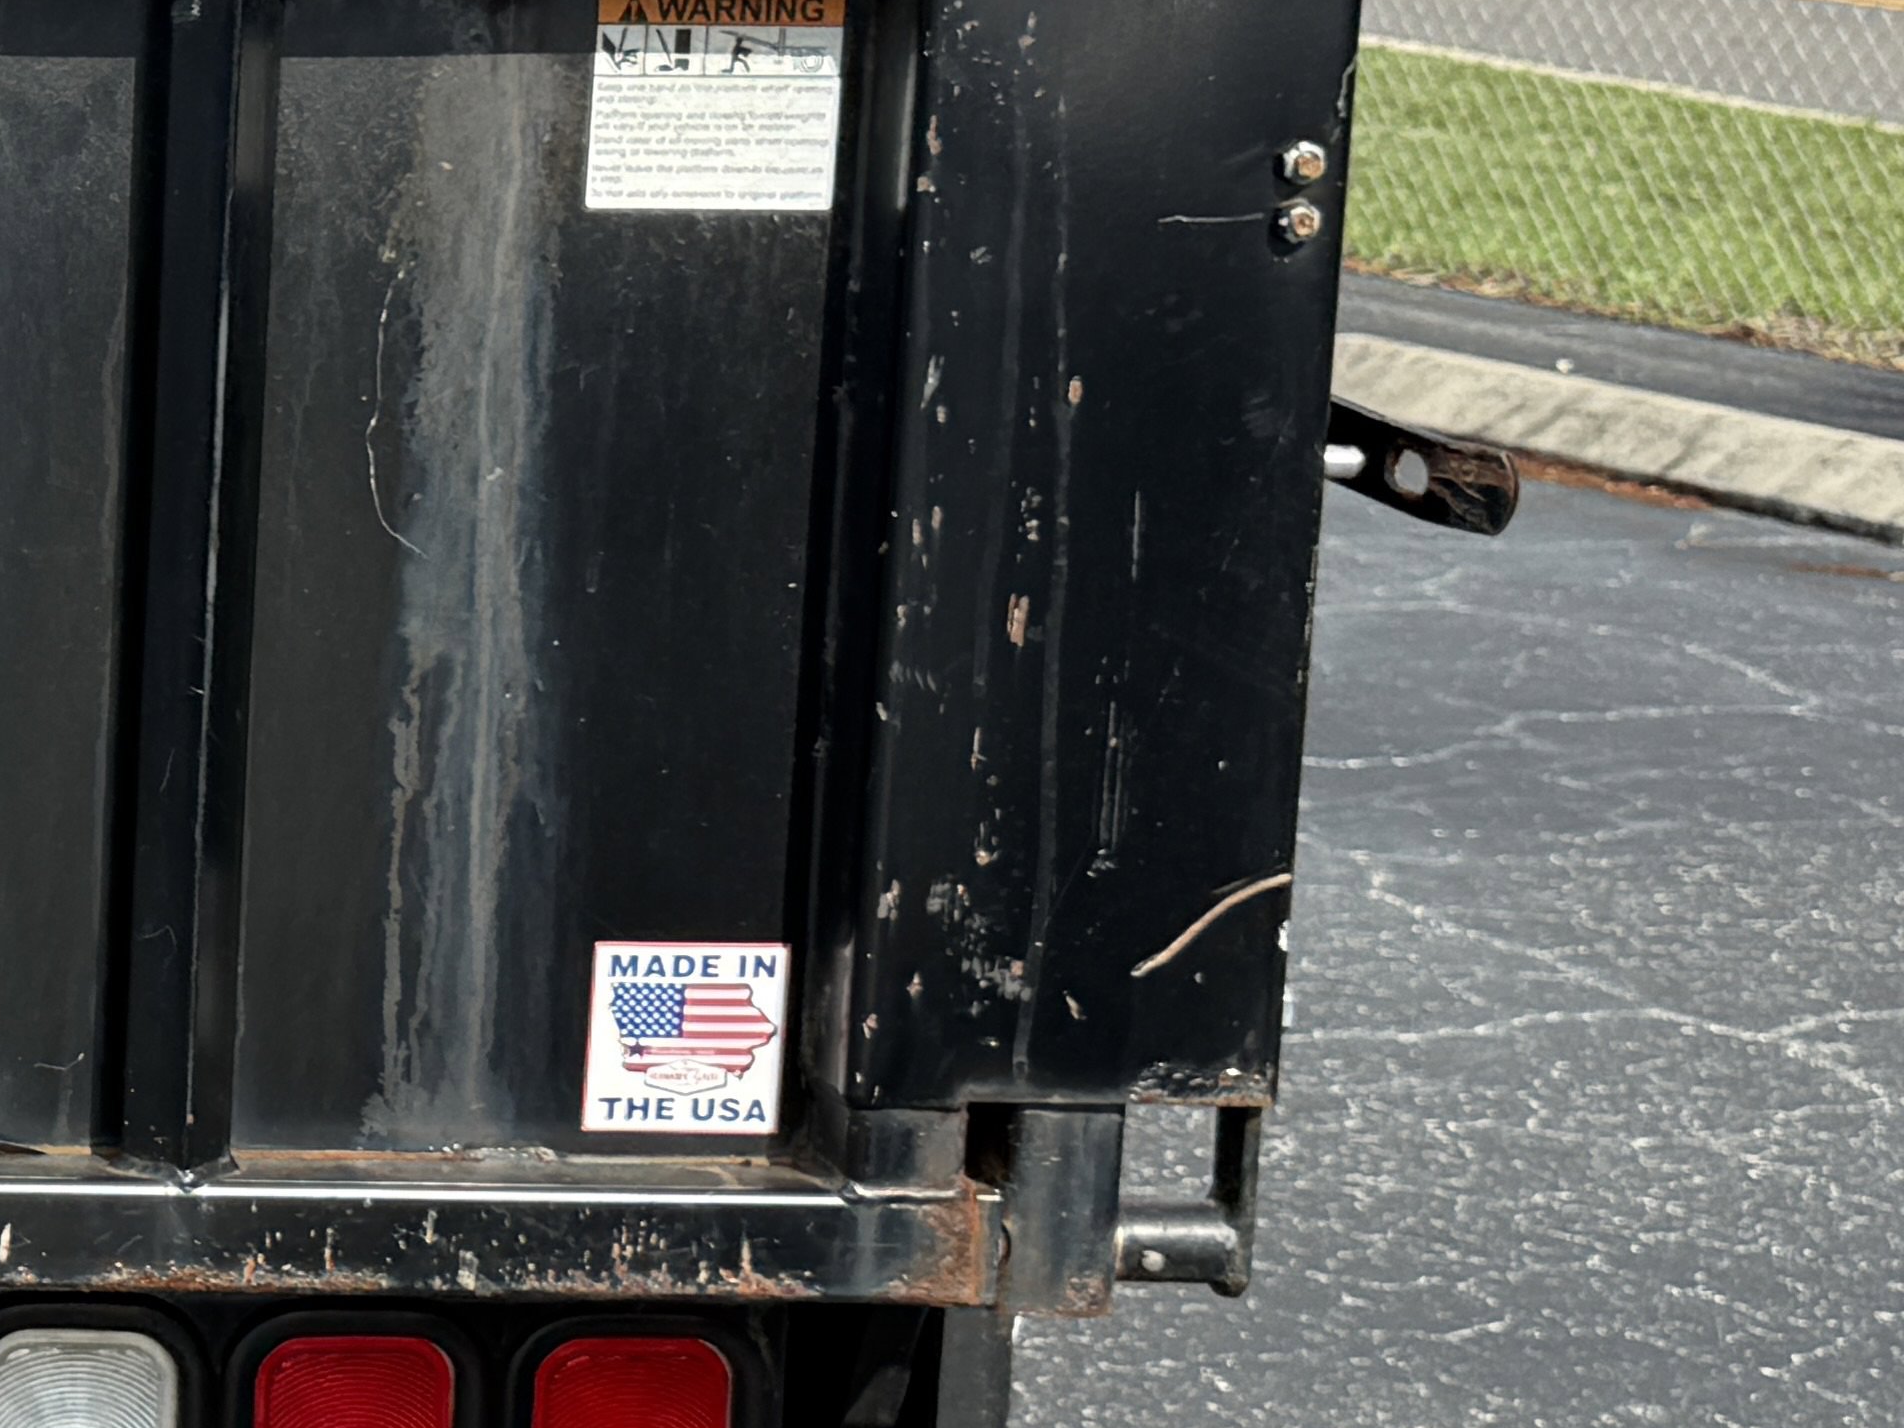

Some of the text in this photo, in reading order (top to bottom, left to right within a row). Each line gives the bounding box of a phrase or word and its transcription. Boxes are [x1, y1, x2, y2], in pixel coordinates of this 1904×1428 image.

[608, 954, 777, 978] MADE IN
[598, 1097, 766, 1122] THE USA
